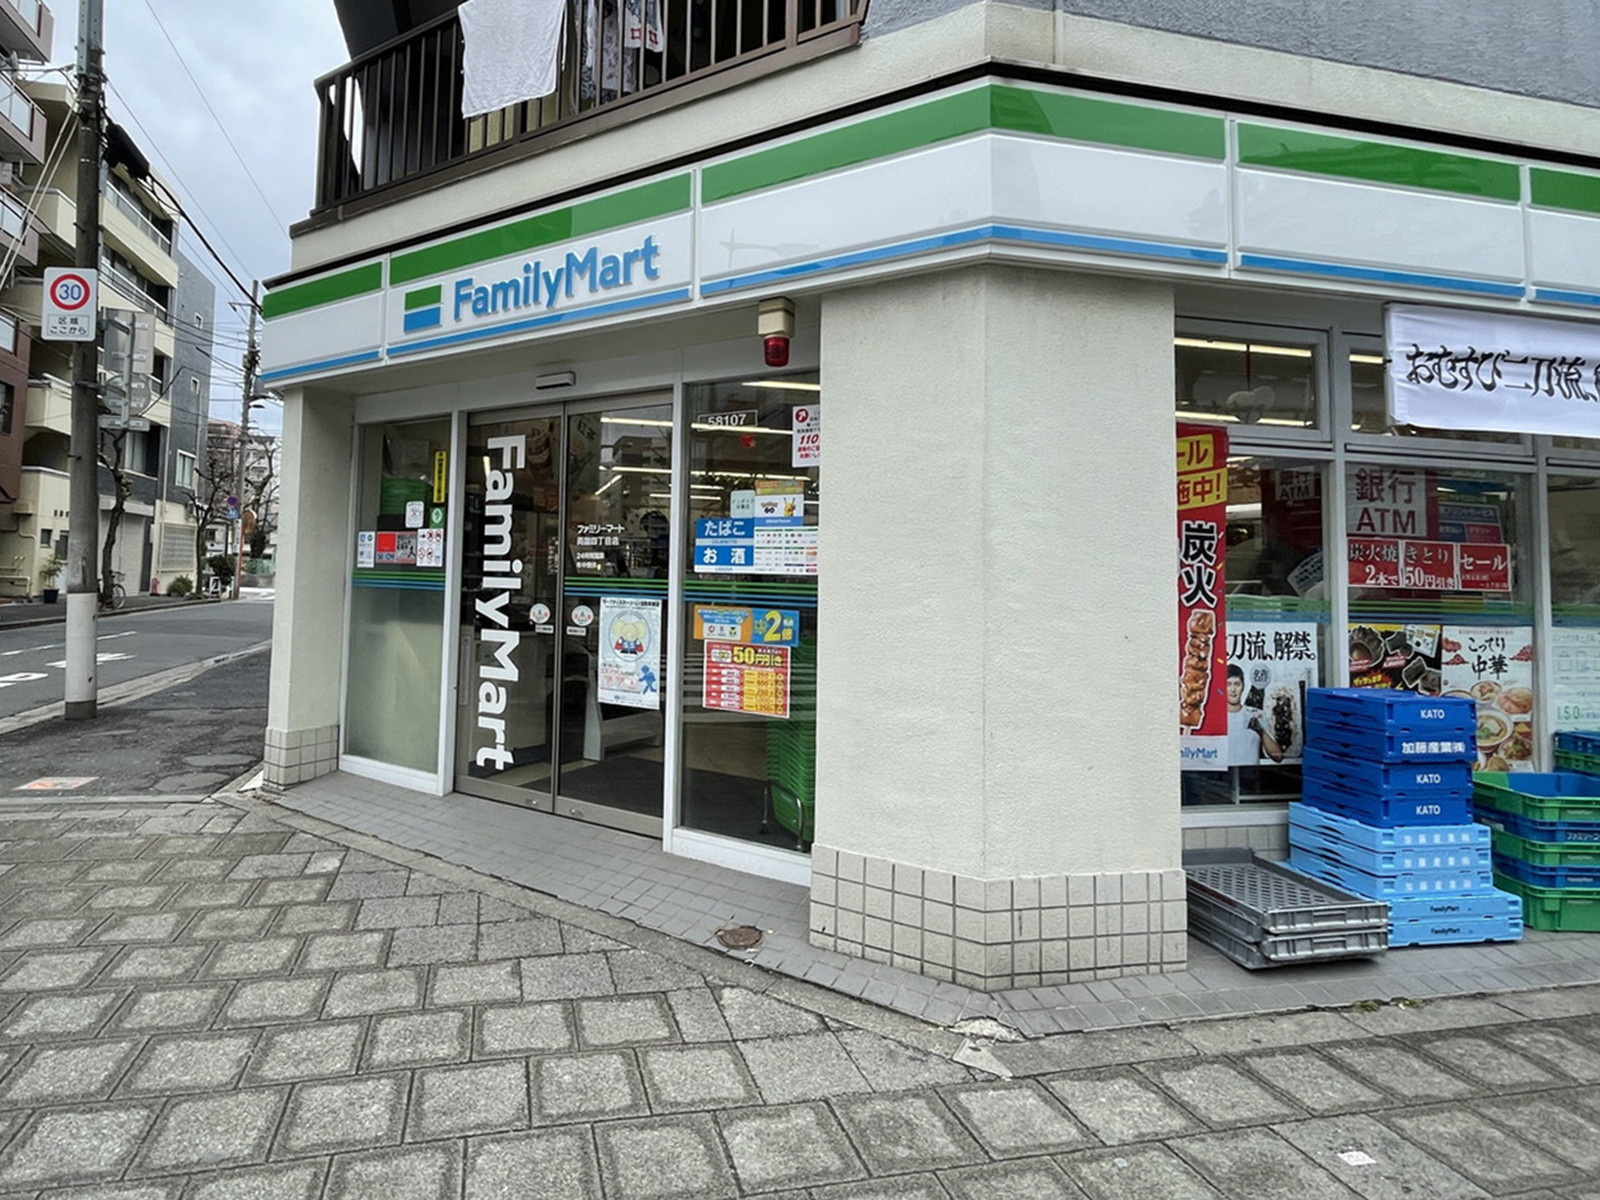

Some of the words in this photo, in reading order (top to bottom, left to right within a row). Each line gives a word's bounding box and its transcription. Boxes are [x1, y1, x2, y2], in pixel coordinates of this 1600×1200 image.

[454, 235, 660, 321] FamilyMart
[59, 283, 82, 301] 30
[58, 316, 79, 325] 区域
[50, 325, 87, 335] ここから
[1406, 344, 1600, 402] おむすび二刀流、
[708, 413, 747, 427] 58107
[800, 434, 819, 445] 110
[1280, 485, 1310, 499] ATM
[1355, 467, 1416, 504] 銀行
[1356, 507, 1416, 534] ATM
[704, 520, 746, 537] たばこ
[1181, 521, 1217, 608] 炭火
[1460, 553, 1507, 571] セール
[475, 435, 526, 770] FamilyMart
[1227, 631, 1317, 661] 刀流、解禁。
[1468, 637, 1506, 651] こってり
[1471, 655, 1509, 680] 中華
[1420, 708, 1446, 719] KATO
[1416, 774, 1441, 784] KATO
[1415, 805, 1441, 815] KATO
[1430, 905, 1460, 913] FamilyMart
[1431, 927, 1461, 936] FamilyMart
